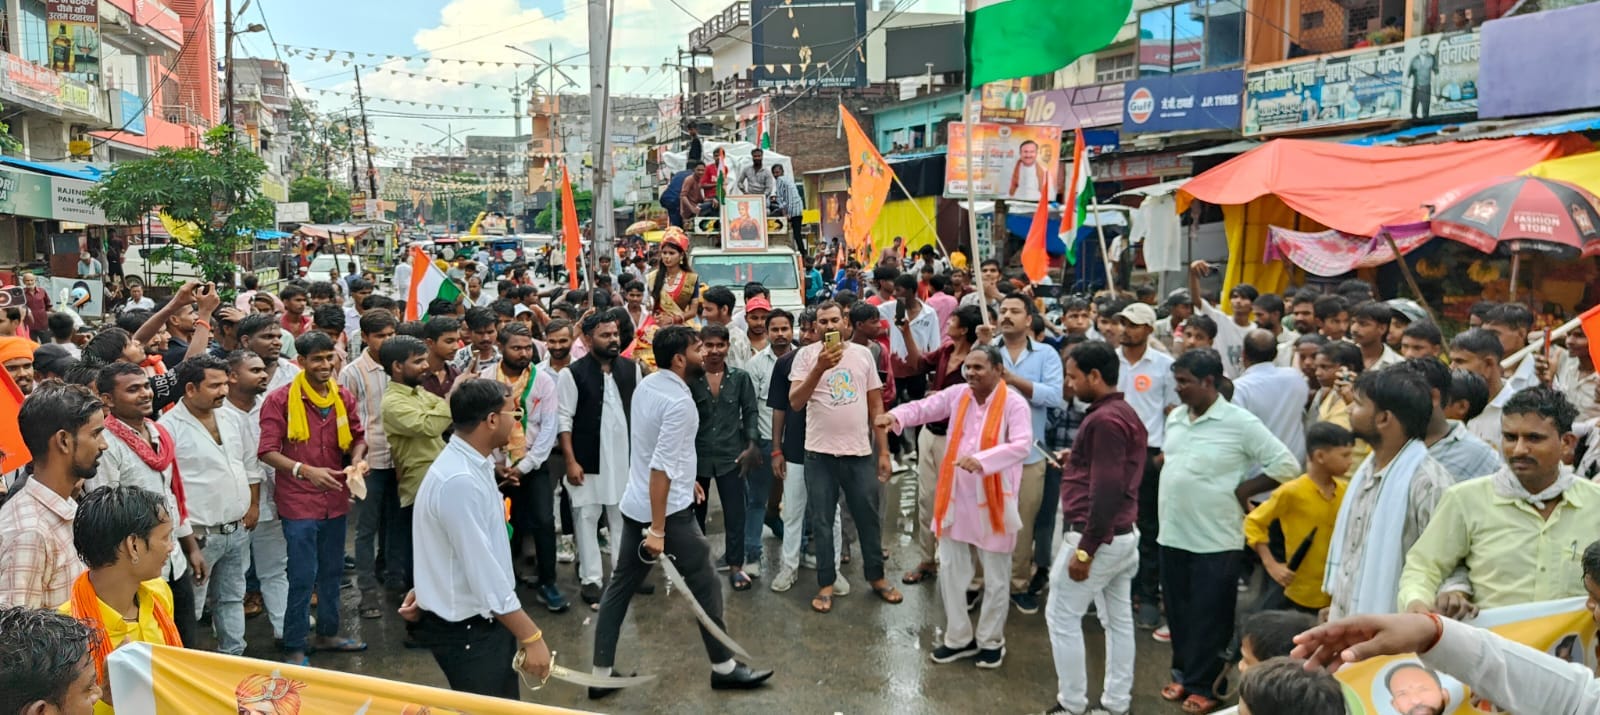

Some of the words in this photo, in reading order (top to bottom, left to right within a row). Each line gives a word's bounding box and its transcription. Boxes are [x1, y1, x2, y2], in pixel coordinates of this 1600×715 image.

[74, 5, 86, 14] की
[1264, 69, 1293, 92] किशोर
[1294, 68, 1316, 94] गुप्ता
[1214, 94, 1239, 106] TYRES
[1026, 94, 1056, 123] llo
[1130, 101, 1153, 111] Gulf
[57, 187, 88, 197] RAJEND
[58, 196, 74, 204] PAN
[1513, 215, 1560, 227] FASHION
[1519, 223, 1553, 234] STORE
